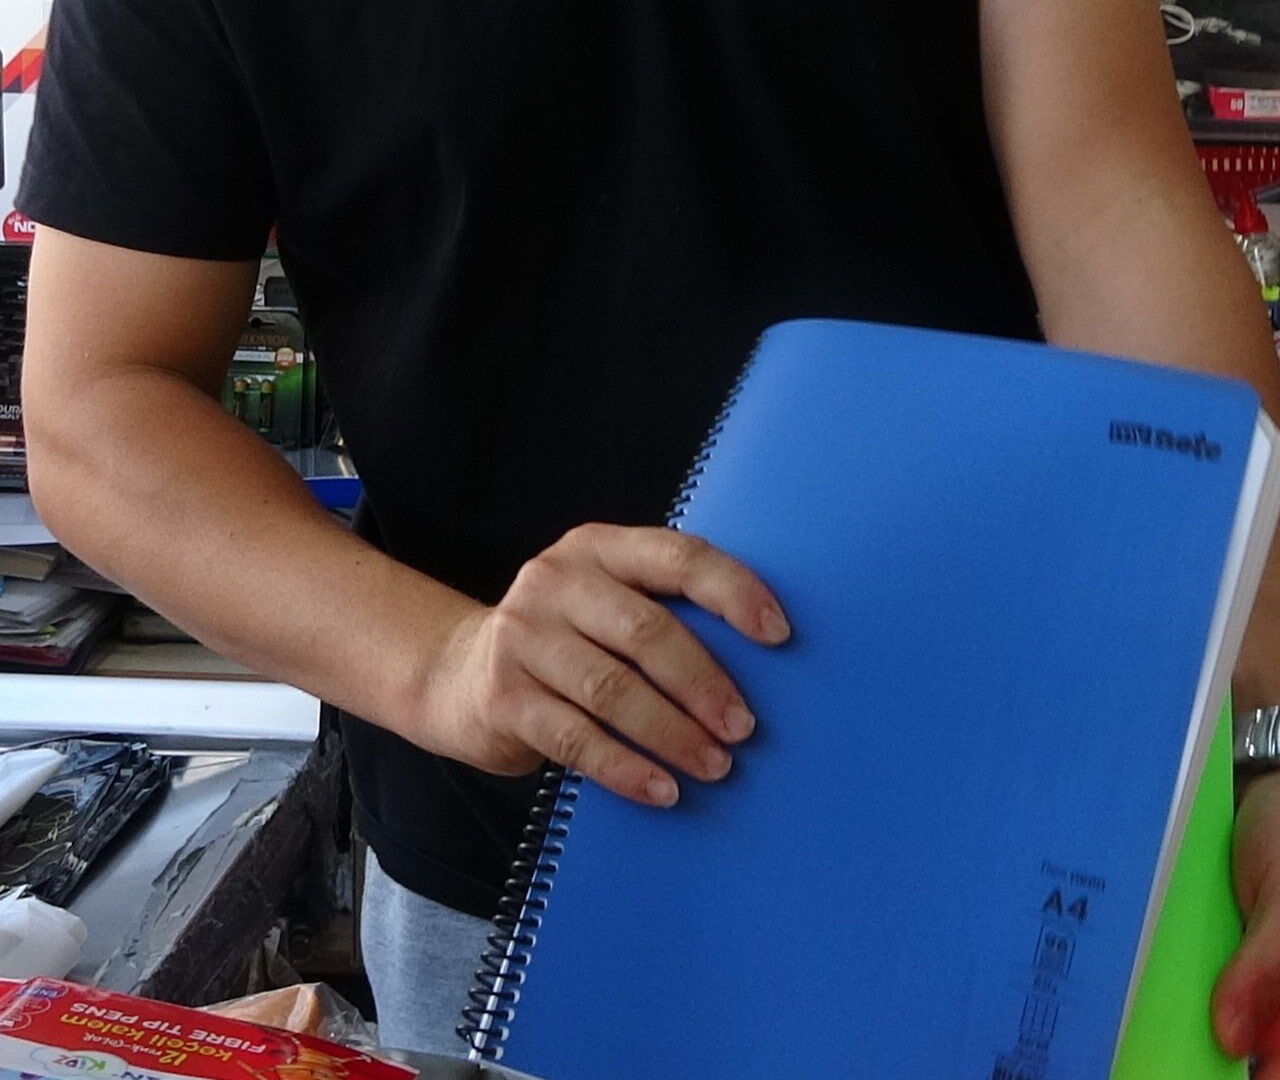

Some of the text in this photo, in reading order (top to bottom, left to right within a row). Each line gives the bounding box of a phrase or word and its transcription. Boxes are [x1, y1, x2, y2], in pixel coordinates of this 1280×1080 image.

[1042, 885, 1089, 926] A4
[70, 1002, 267, 1054] FIBRE TIP PENS
[159, 1051, 189, 1067] 12
